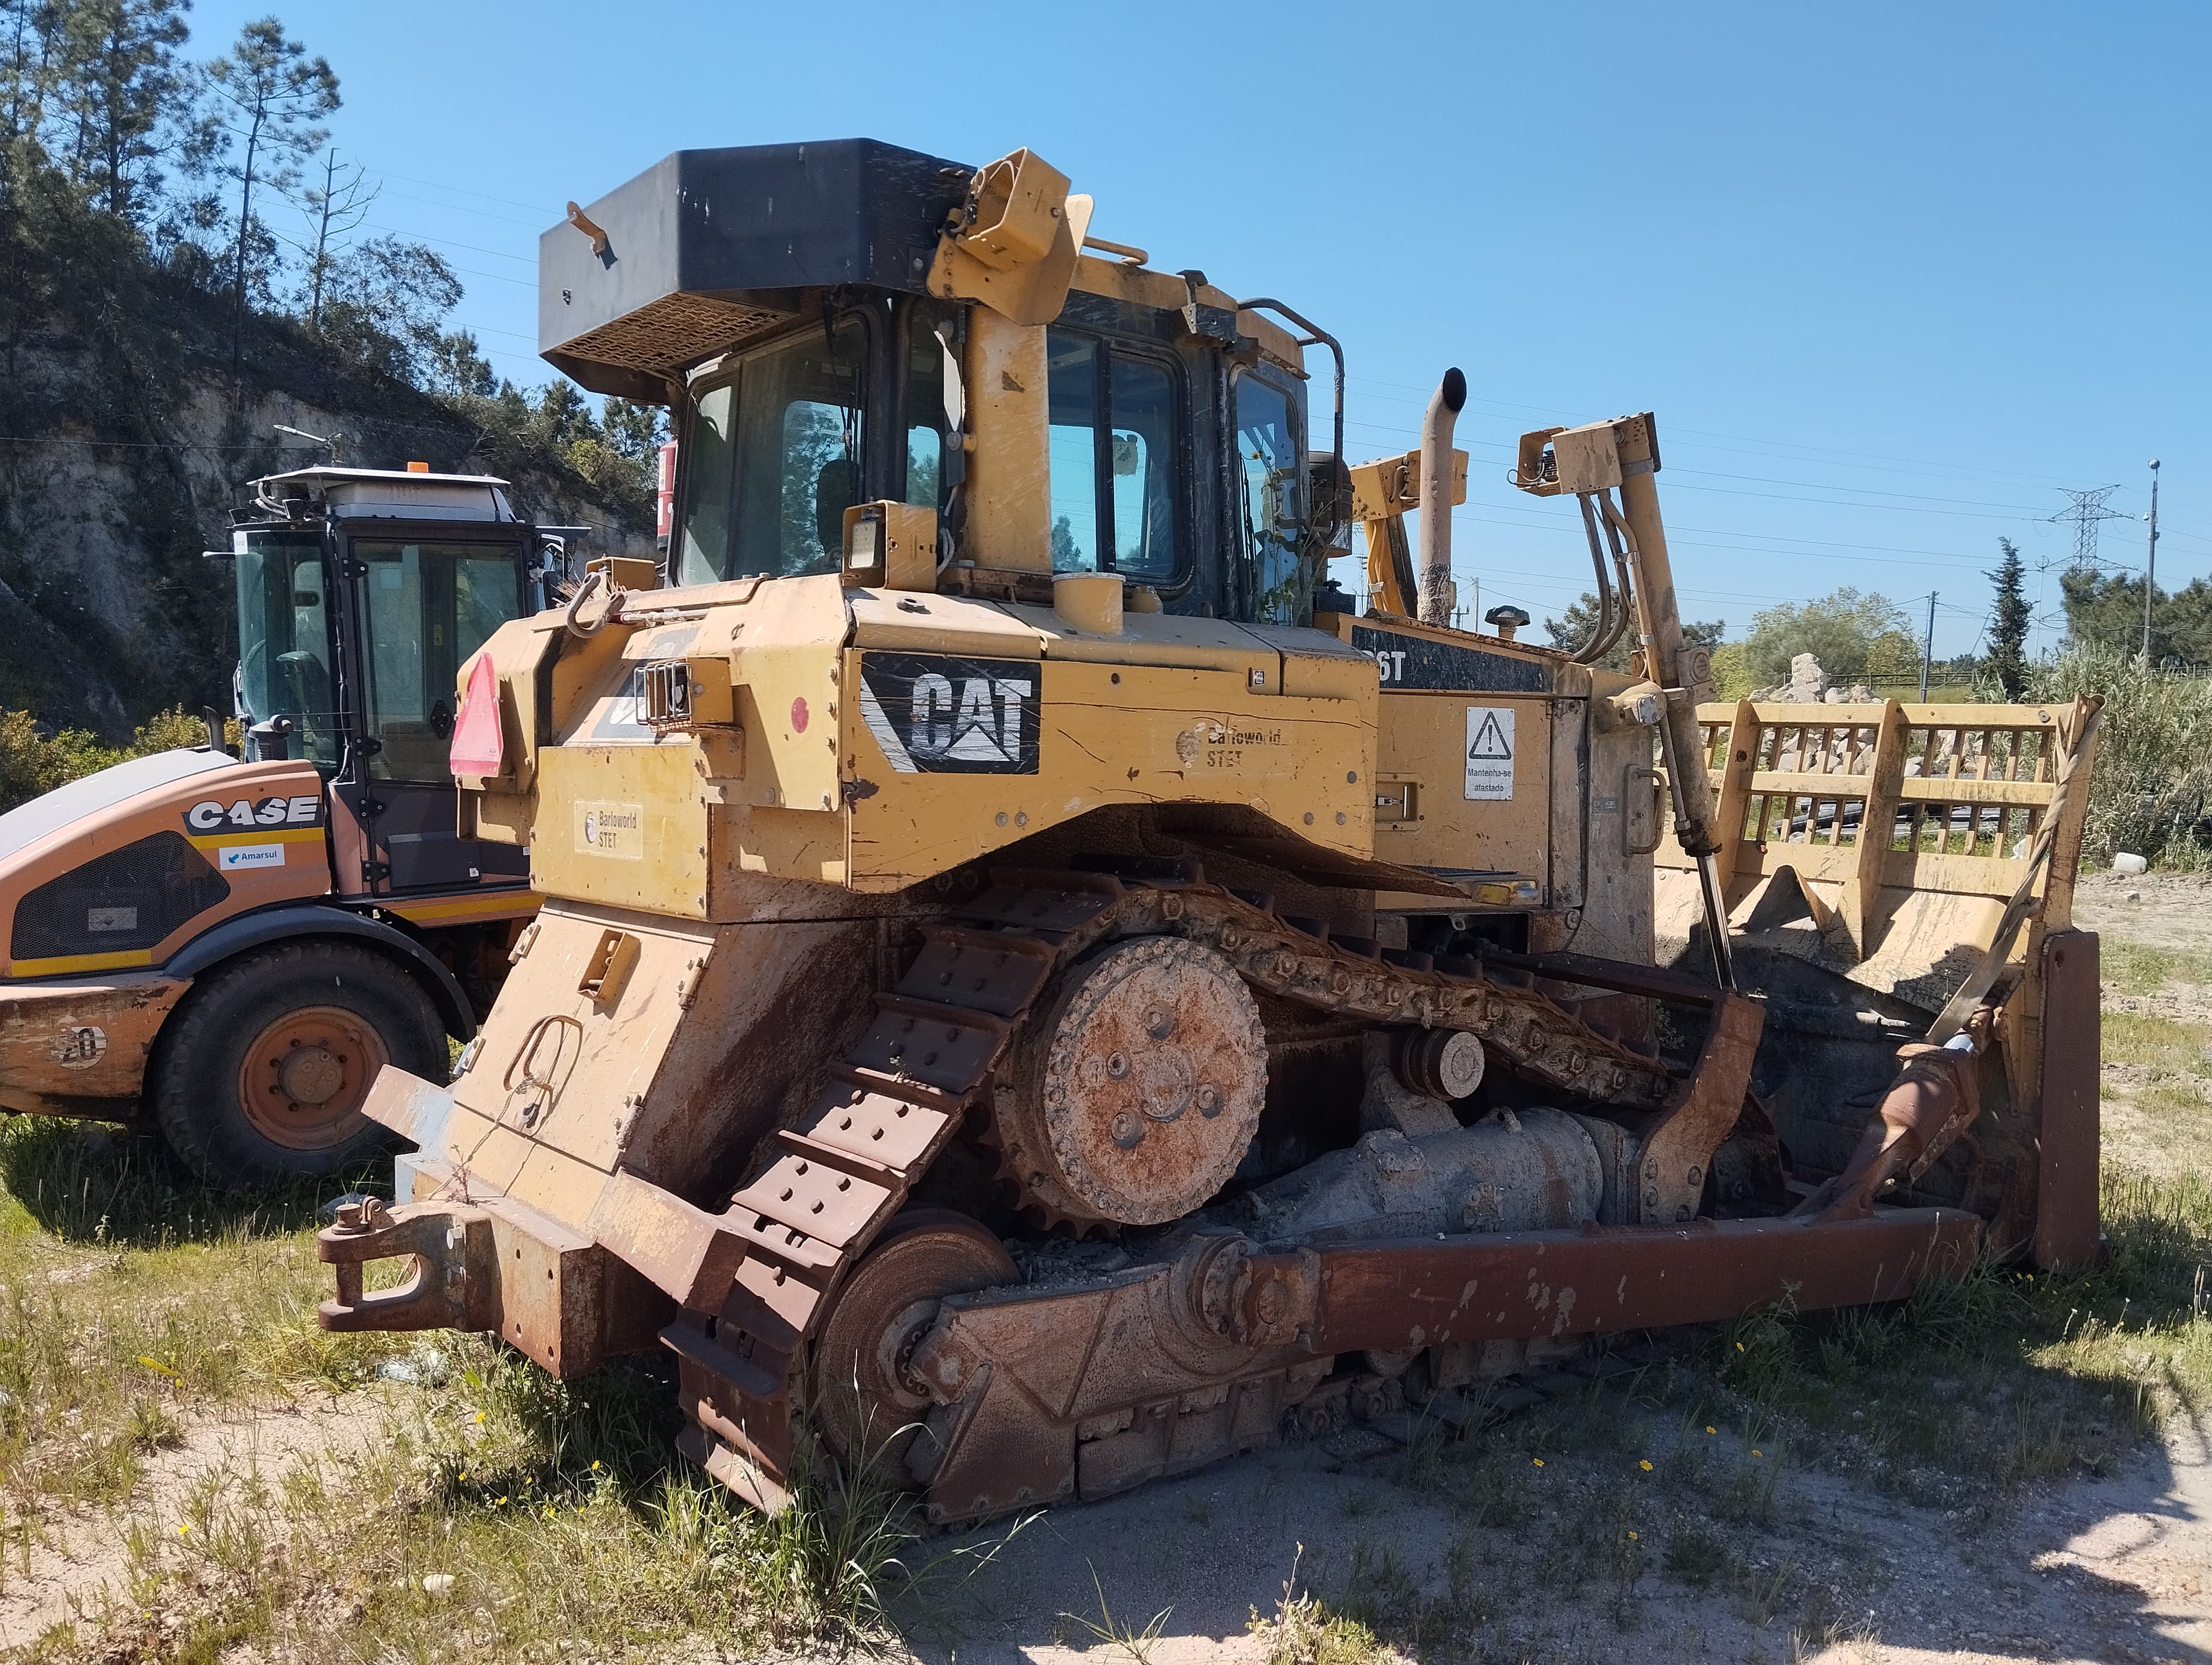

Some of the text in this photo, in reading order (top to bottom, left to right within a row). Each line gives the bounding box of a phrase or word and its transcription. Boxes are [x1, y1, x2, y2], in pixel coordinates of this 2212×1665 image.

[1361, 650, 1406, 681] 6T
[912, 673, 1032, 761] CAT
[1468, 768, 1512, 777] Mantenha-se
[1474, 783, 1504, 792] afastado
[190, 796, 319, 829] CASE
[599, 810, 637, 829] Barloworld
[599, 832, 617, 848] STET
[241, 851, 277, 860] Amarsul
